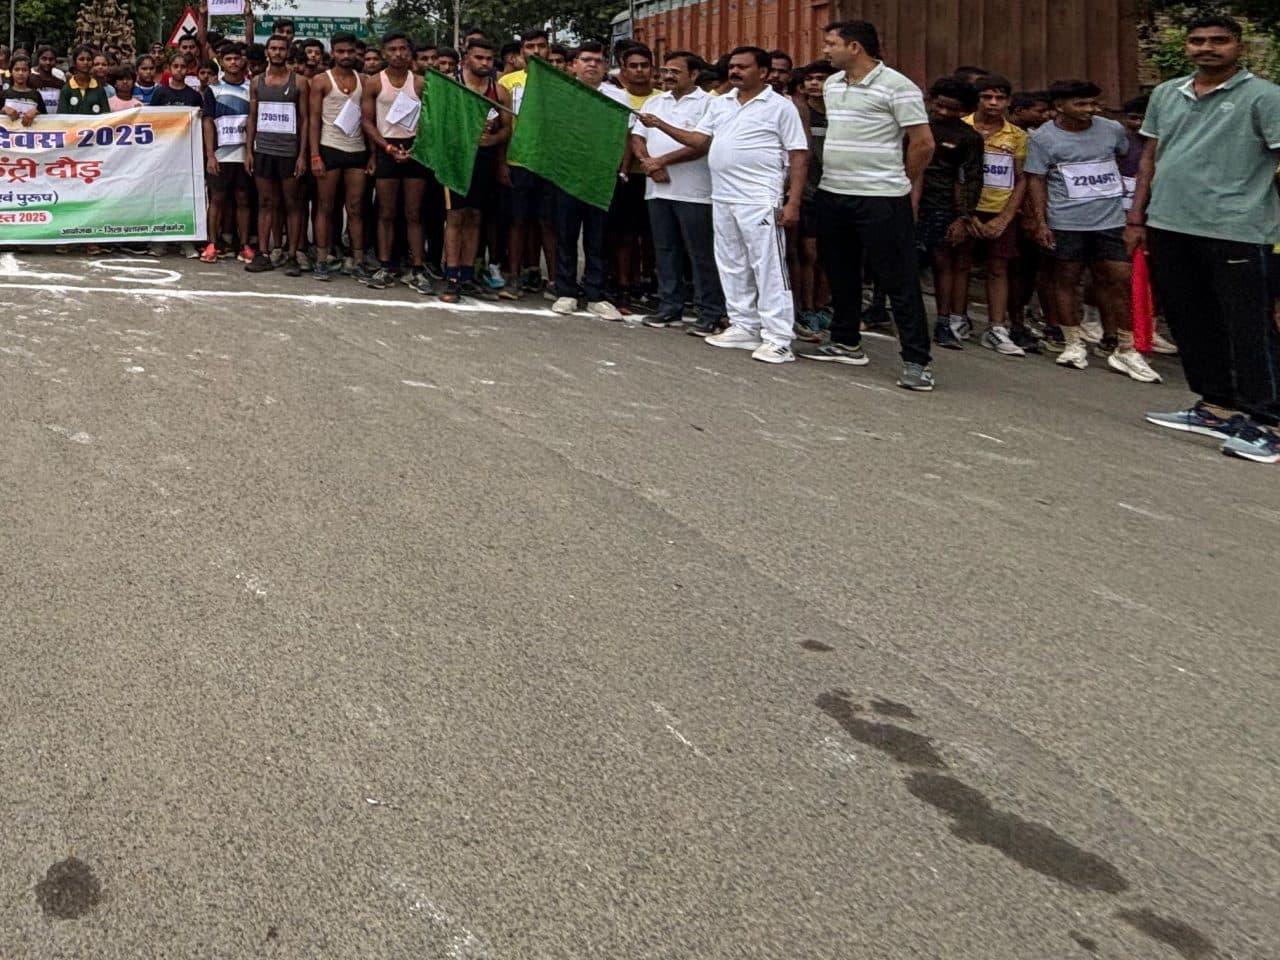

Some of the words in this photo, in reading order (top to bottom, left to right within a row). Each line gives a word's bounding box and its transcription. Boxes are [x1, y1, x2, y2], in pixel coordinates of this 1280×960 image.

[78, 123, 154, 147] 2025
[45, 156, 103, 184] दौड़
[19, 213, 47, 222] 2025
